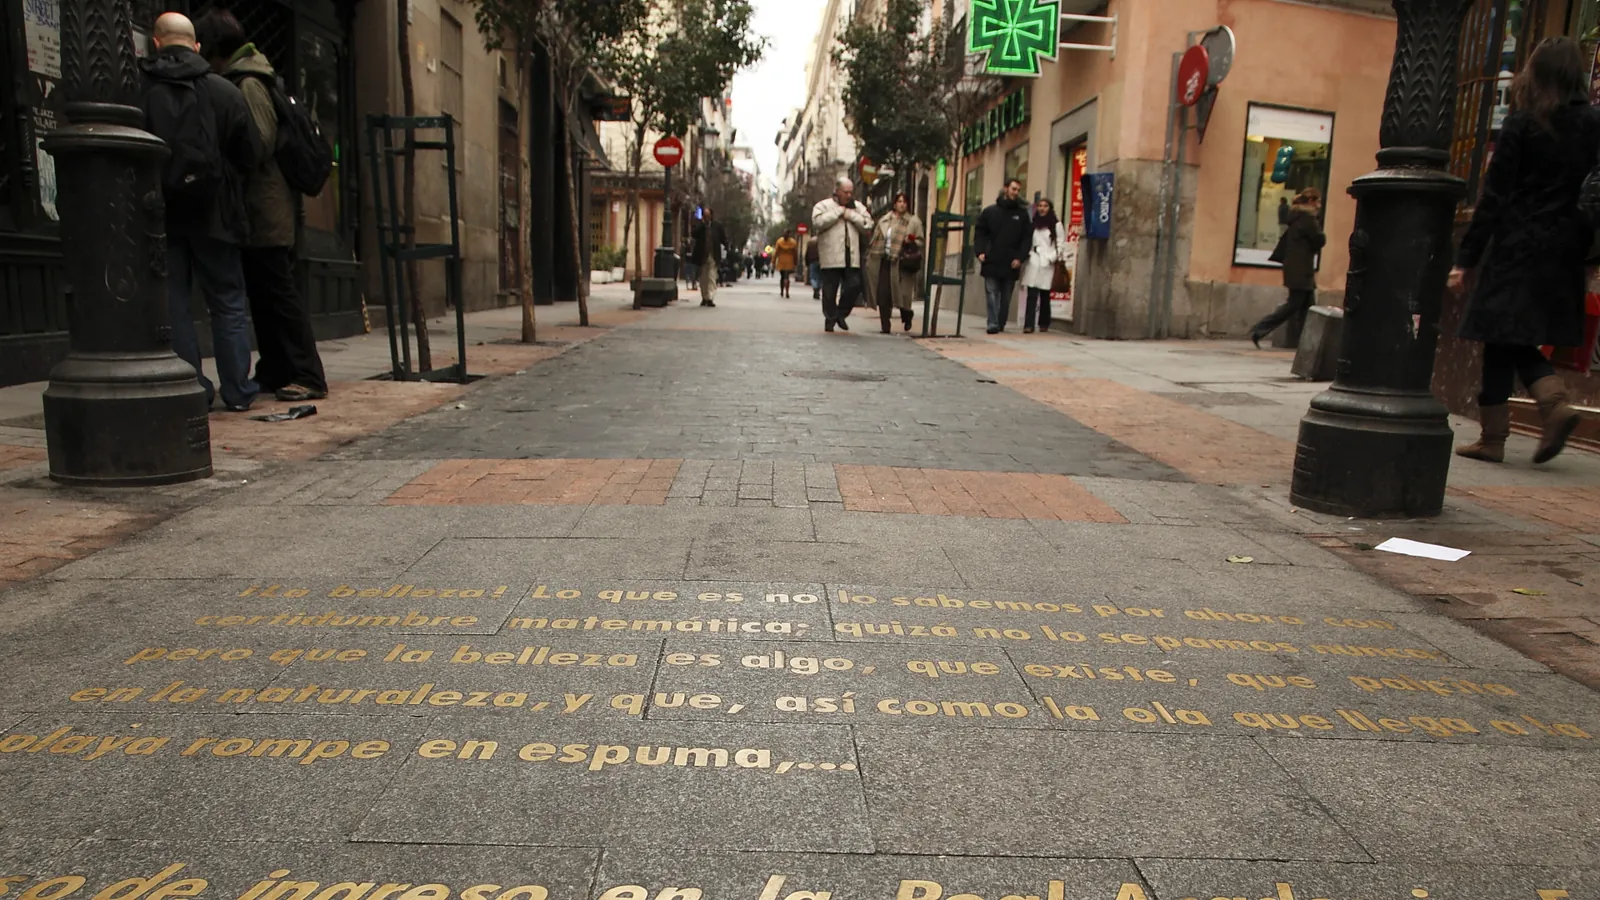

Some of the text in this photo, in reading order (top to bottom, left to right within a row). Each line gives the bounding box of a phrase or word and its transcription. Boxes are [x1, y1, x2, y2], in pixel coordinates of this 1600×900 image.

[328, 583, 508, 600] belleza!
[531, 584, 581, 600] Lo
[597, 589, 678, 604] que
[697, 591, 744, 604] es
[762, 590, 819, 607] no
[838, 589, 877, 606] lo
[891, 593, 1083, 614] sabemos
[1091, 604, 1165, 618] por
[1183, 607, 1305, 626] ahora
[1322, 616, 1396, 631] con
[194, 609, 478, 628] certidumbre
[507, 615, 810, 637] matemática;
[834, 619, 958, 638] quizá
[972, 627, 1031, 641] no
[1039, 624, 1089, 643] lo
[1096, 632, 1301, 654] sepamos
[123, 646, 255, 666] pero
[267, 647, 369, 666] que
[383, 642, 434, 664] la
[449, 644, 638, 667] belleza
[666, 652, 721, 667] es
[906, 659, 1000, 679] que
[1225, 672, 1316, 692] que
[68, 686, 145, 703] en
[147, 679, 209, 704] la
[215, 682, 550, 712] naturaleza,
[561, 692, 593, 715] y
[775, 690, 856, 713] así
[876, 698, 1030, 719] como
[1043, 695, 1101, 721] la
[1121, 700, 1213, 726] ola
[1231, 711, 1335, 731] que
[1335, 708, 1480, 739] llega
[1517, 713, 1593, 739] la
[179, 736, 392, 766] rompe
[416, 738, 498, 761] en
